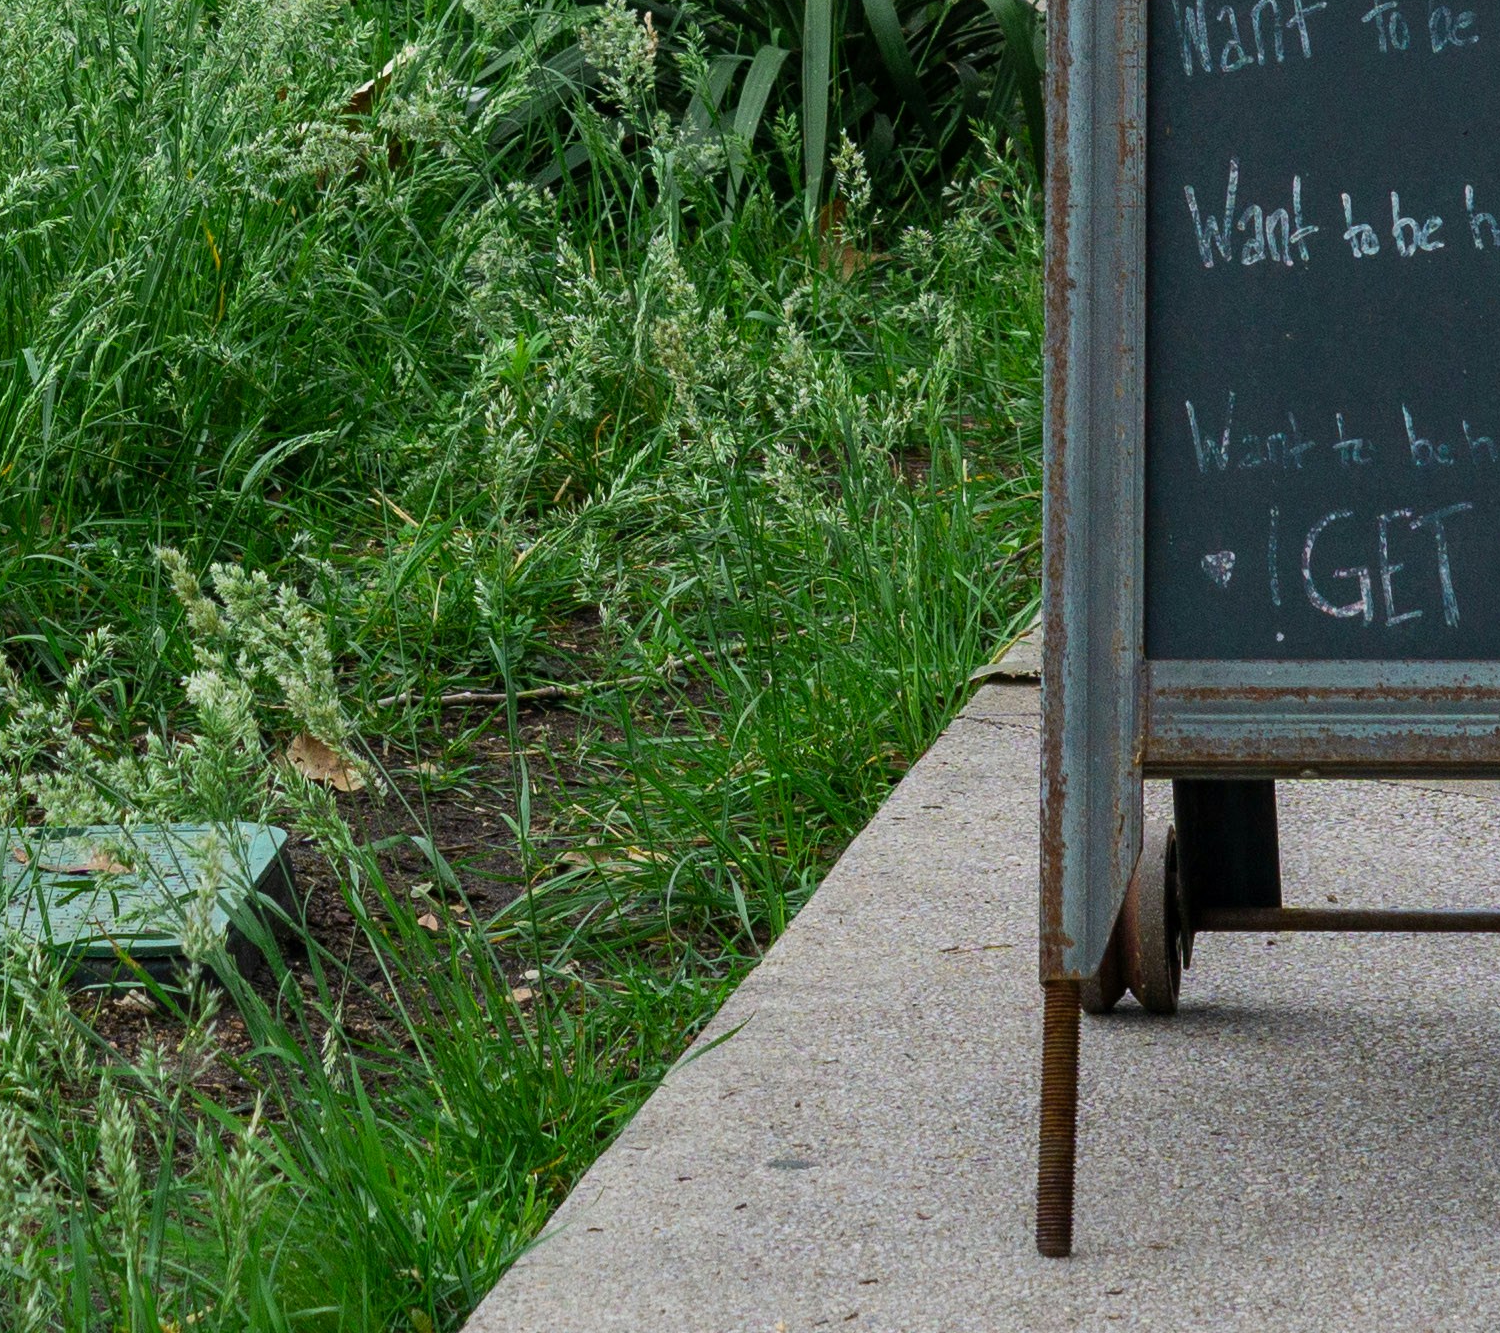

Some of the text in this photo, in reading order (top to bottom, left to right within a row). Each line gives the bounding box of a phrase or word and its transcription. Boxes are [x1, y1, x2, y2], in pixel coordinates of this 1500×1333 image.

[1183, 156, 1320, 269] Want
[1340, 192, 1381, 259] to
[1390, 190, 1445, 258] be
[1184, 389, 1317, 473] Want
